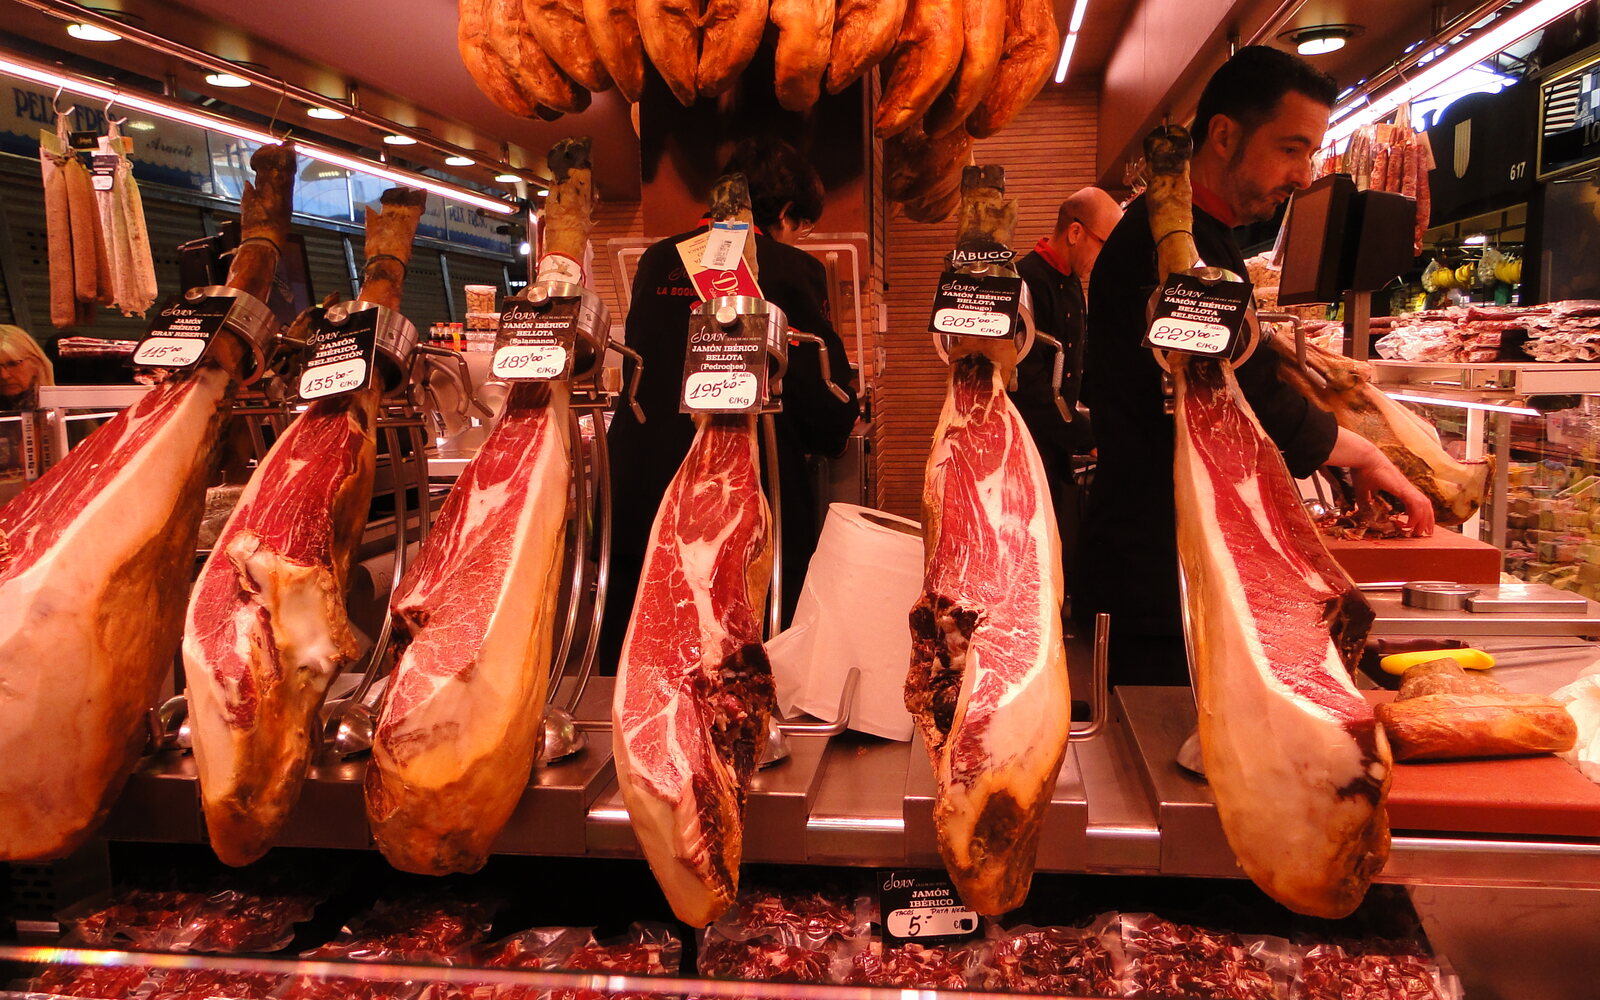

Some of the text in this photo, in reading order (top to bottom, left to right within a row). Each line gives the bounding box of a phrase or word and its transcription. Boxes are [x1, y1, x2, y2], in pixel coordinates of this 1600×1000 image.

[1510, 161, 1526, 180] 617
[952, 249, 1013, 261] JABUGO
[941, 280, 979, 292] JOAN
[1164, 283, 1205, 299] JOAN
[942, 290, 973, 298] JAMÓN
[976, 293, 1012, 302] IBÉRICO
[956, 298, 996, 306] BELLOTA
[1164, 296, 1197, 306] JAMÓN
[1198, 301, 1237, 312] IBÉRICO
[161, 304, 197, 317] JOAN
[502, 305, 539, 321] JOAN
[1177, 305, 1219, 316] BELLOTA
[1170, 311, 1221, 323] SELECCIÓN
[503, 321, 570, 329] JAMÓN IBÉRICO
[980, 327, 1002, 335] €/Kg
[151, 330, 174, 338] GRAN
[306, 329, 340, 346] JOAN
[691, 326, 727, 344] JOAN
[319, 337, 356, 350] JAMÓN
[692, 344, 758, 352] JAMÓN IBÉRICO
[1196, 342, 1219, 351] €/Kg
[315, 344, 359, 358] IBÉRICO
[307, 350, 364, 367] SELECCIÓN
[536, 367, 557, 375] €/Kg
[700, 363, 747, 371] (Pedroches)
[340, 380, 358, 388] €/Kg
[728, 397, 750, 406] €/Kg
[883, 872, 915, 891] JOAN
[911, 888, 950, 899] JAMÓN
[910, 898, 954, 908] IBÉRICO
